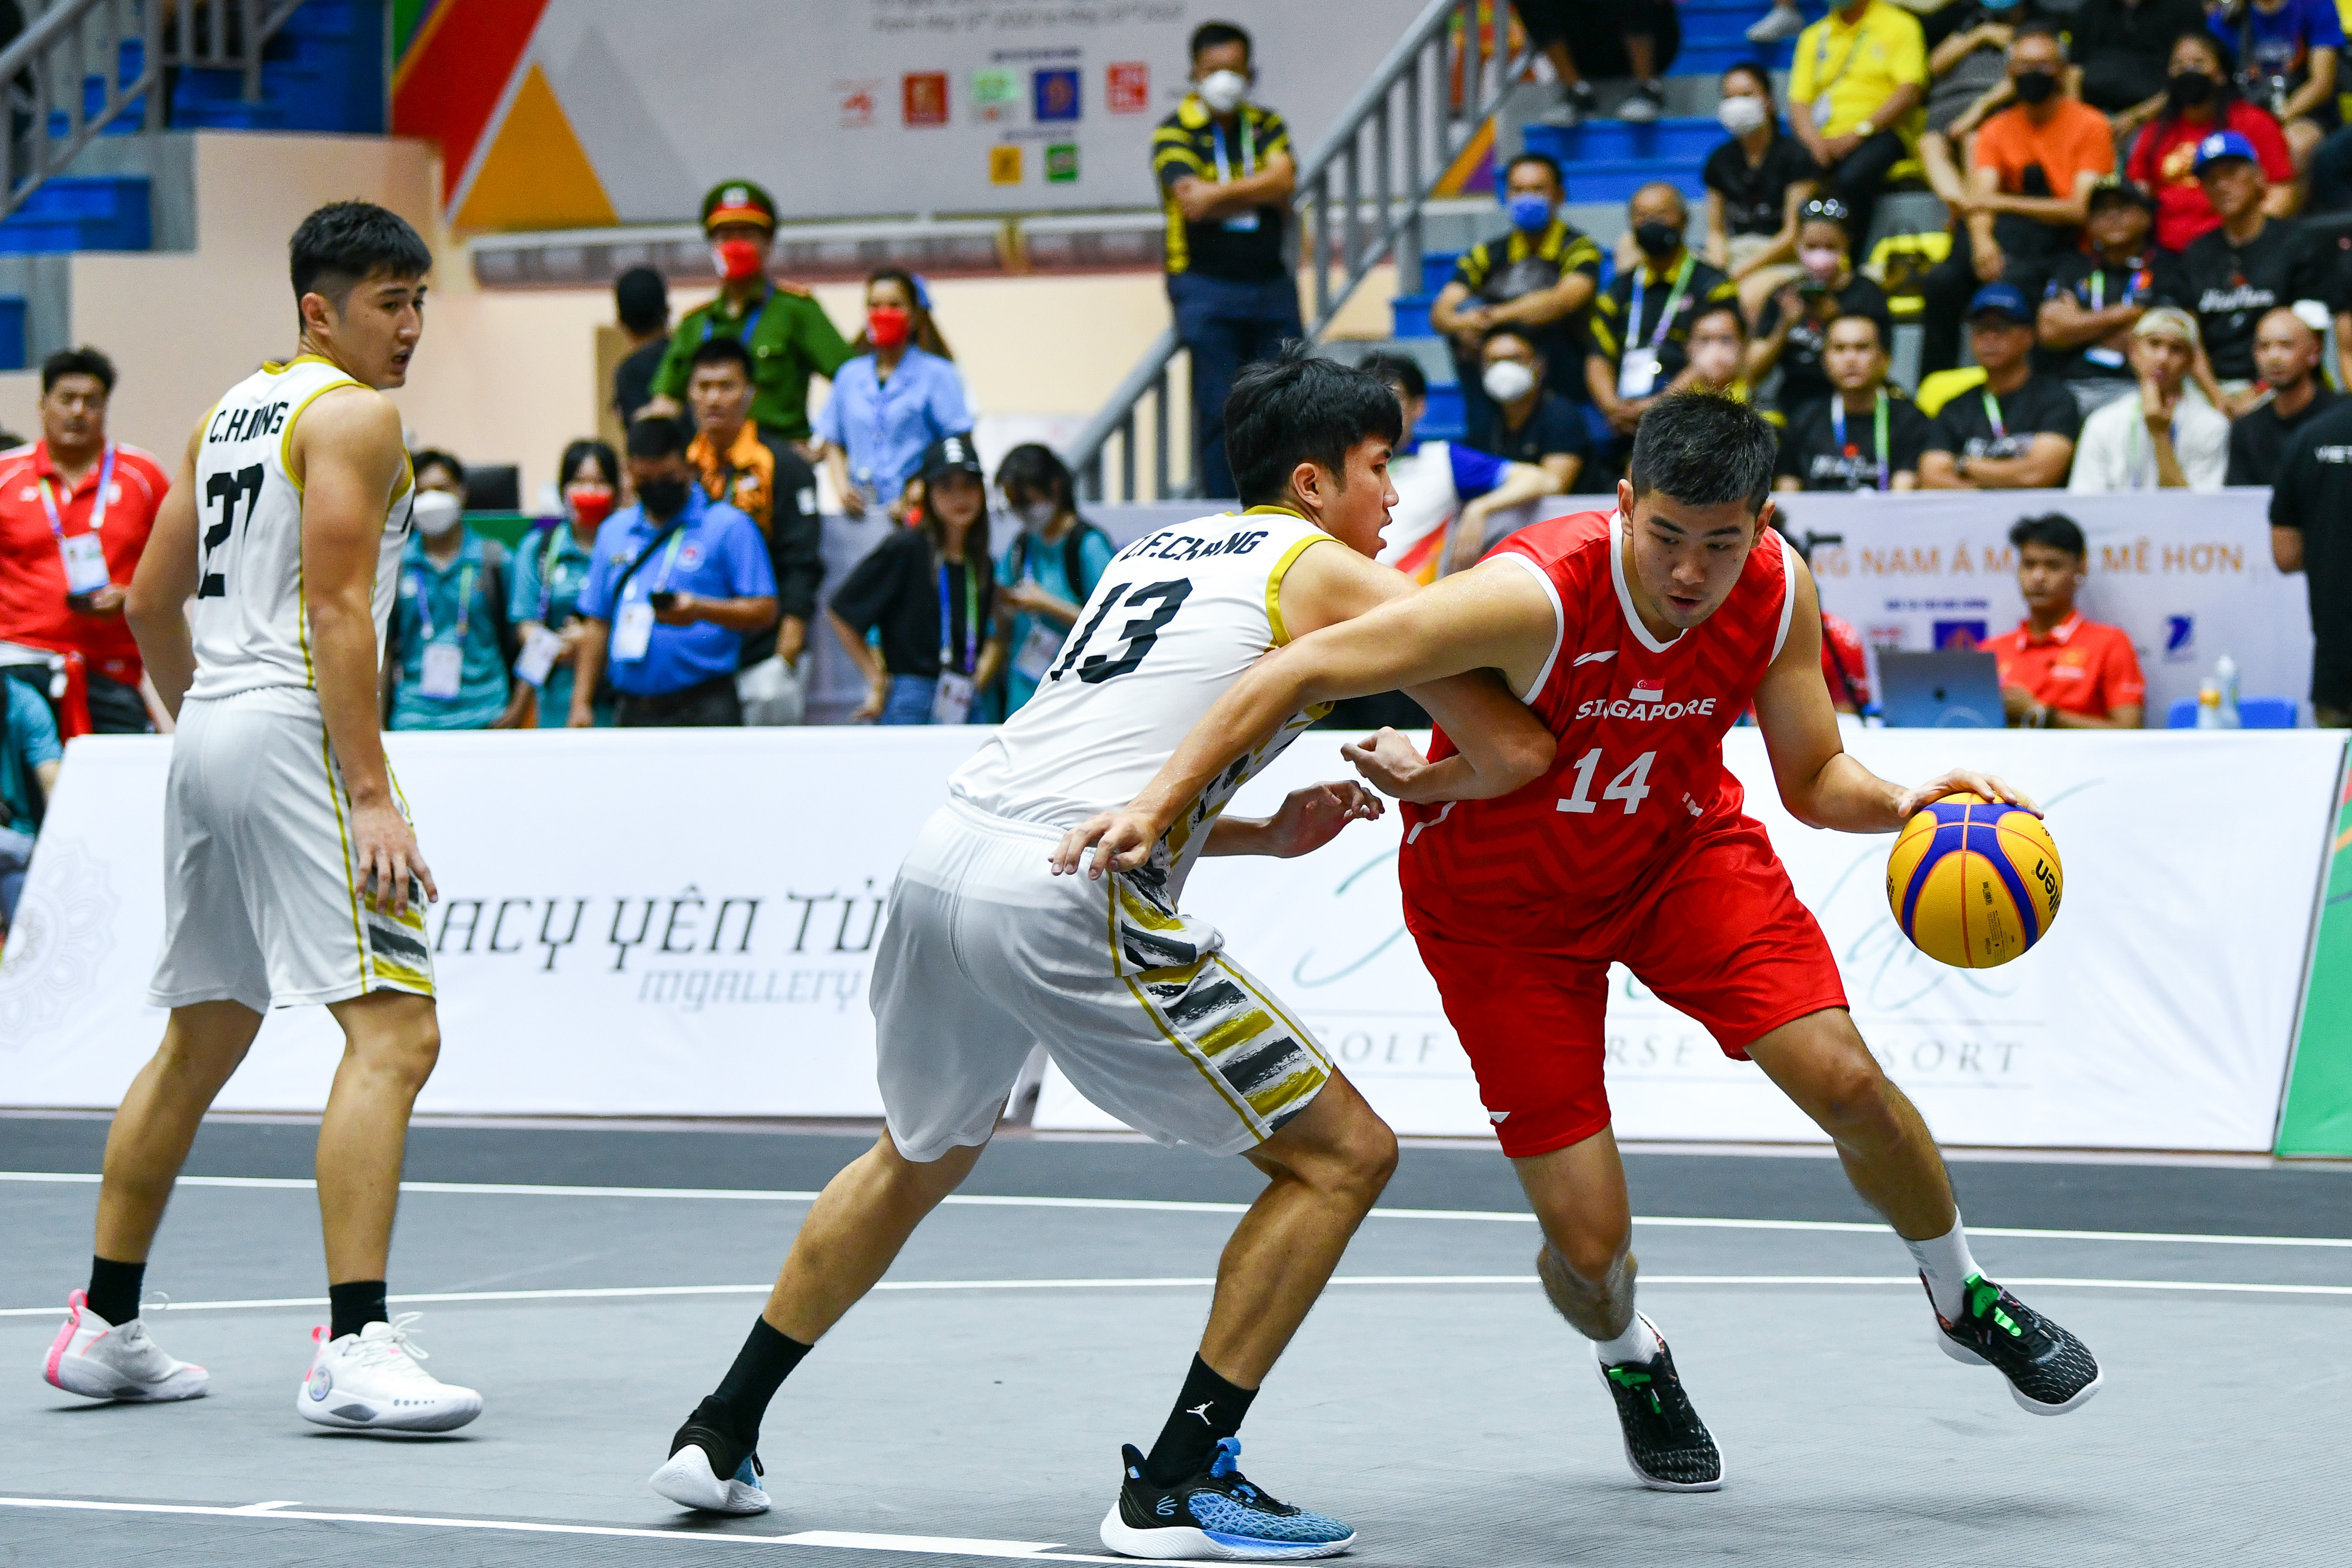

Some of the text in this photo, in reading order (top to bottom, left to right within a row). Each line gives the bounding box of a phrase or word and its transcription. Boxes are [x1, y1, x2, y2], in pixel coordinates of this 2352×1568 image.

[198, 463, 263, 599] 27
[1860, 548, 1940, 575] NAM
[1050, 577, 1192, 683] 13
[1576, 698, 1716, 721] SINGAPORE
[1556, 748, 1656, 814] 14
[435, 898, 590, 972] ACY
[1605, 1033, 1697, 1068] RSE
[1882, 1039, 2024, 1072] SORT
